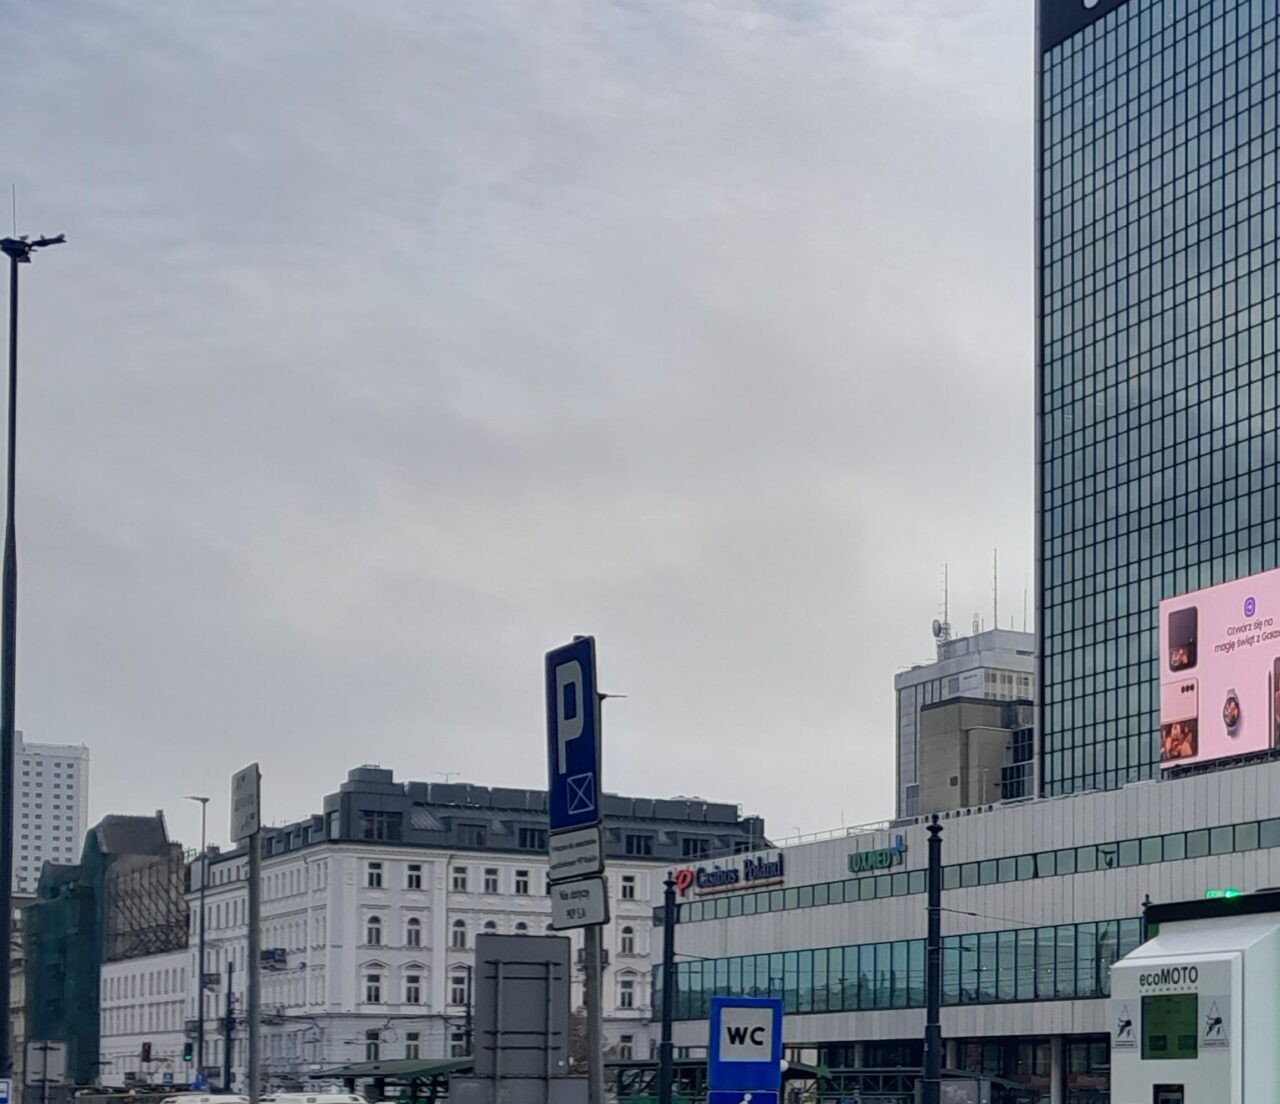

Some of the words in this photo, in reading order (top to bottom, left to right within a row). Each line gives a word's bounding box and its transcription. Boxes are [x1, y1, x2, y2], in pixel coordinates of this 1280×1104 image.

[555, 660, 584, 774] P
[696, 864, 739, 889] Casinos
[743, 852, 784, 881] Poland
[1139, 966, 1199, 987] ecoMOTO
[726, 1026, 766, 1046] WC
